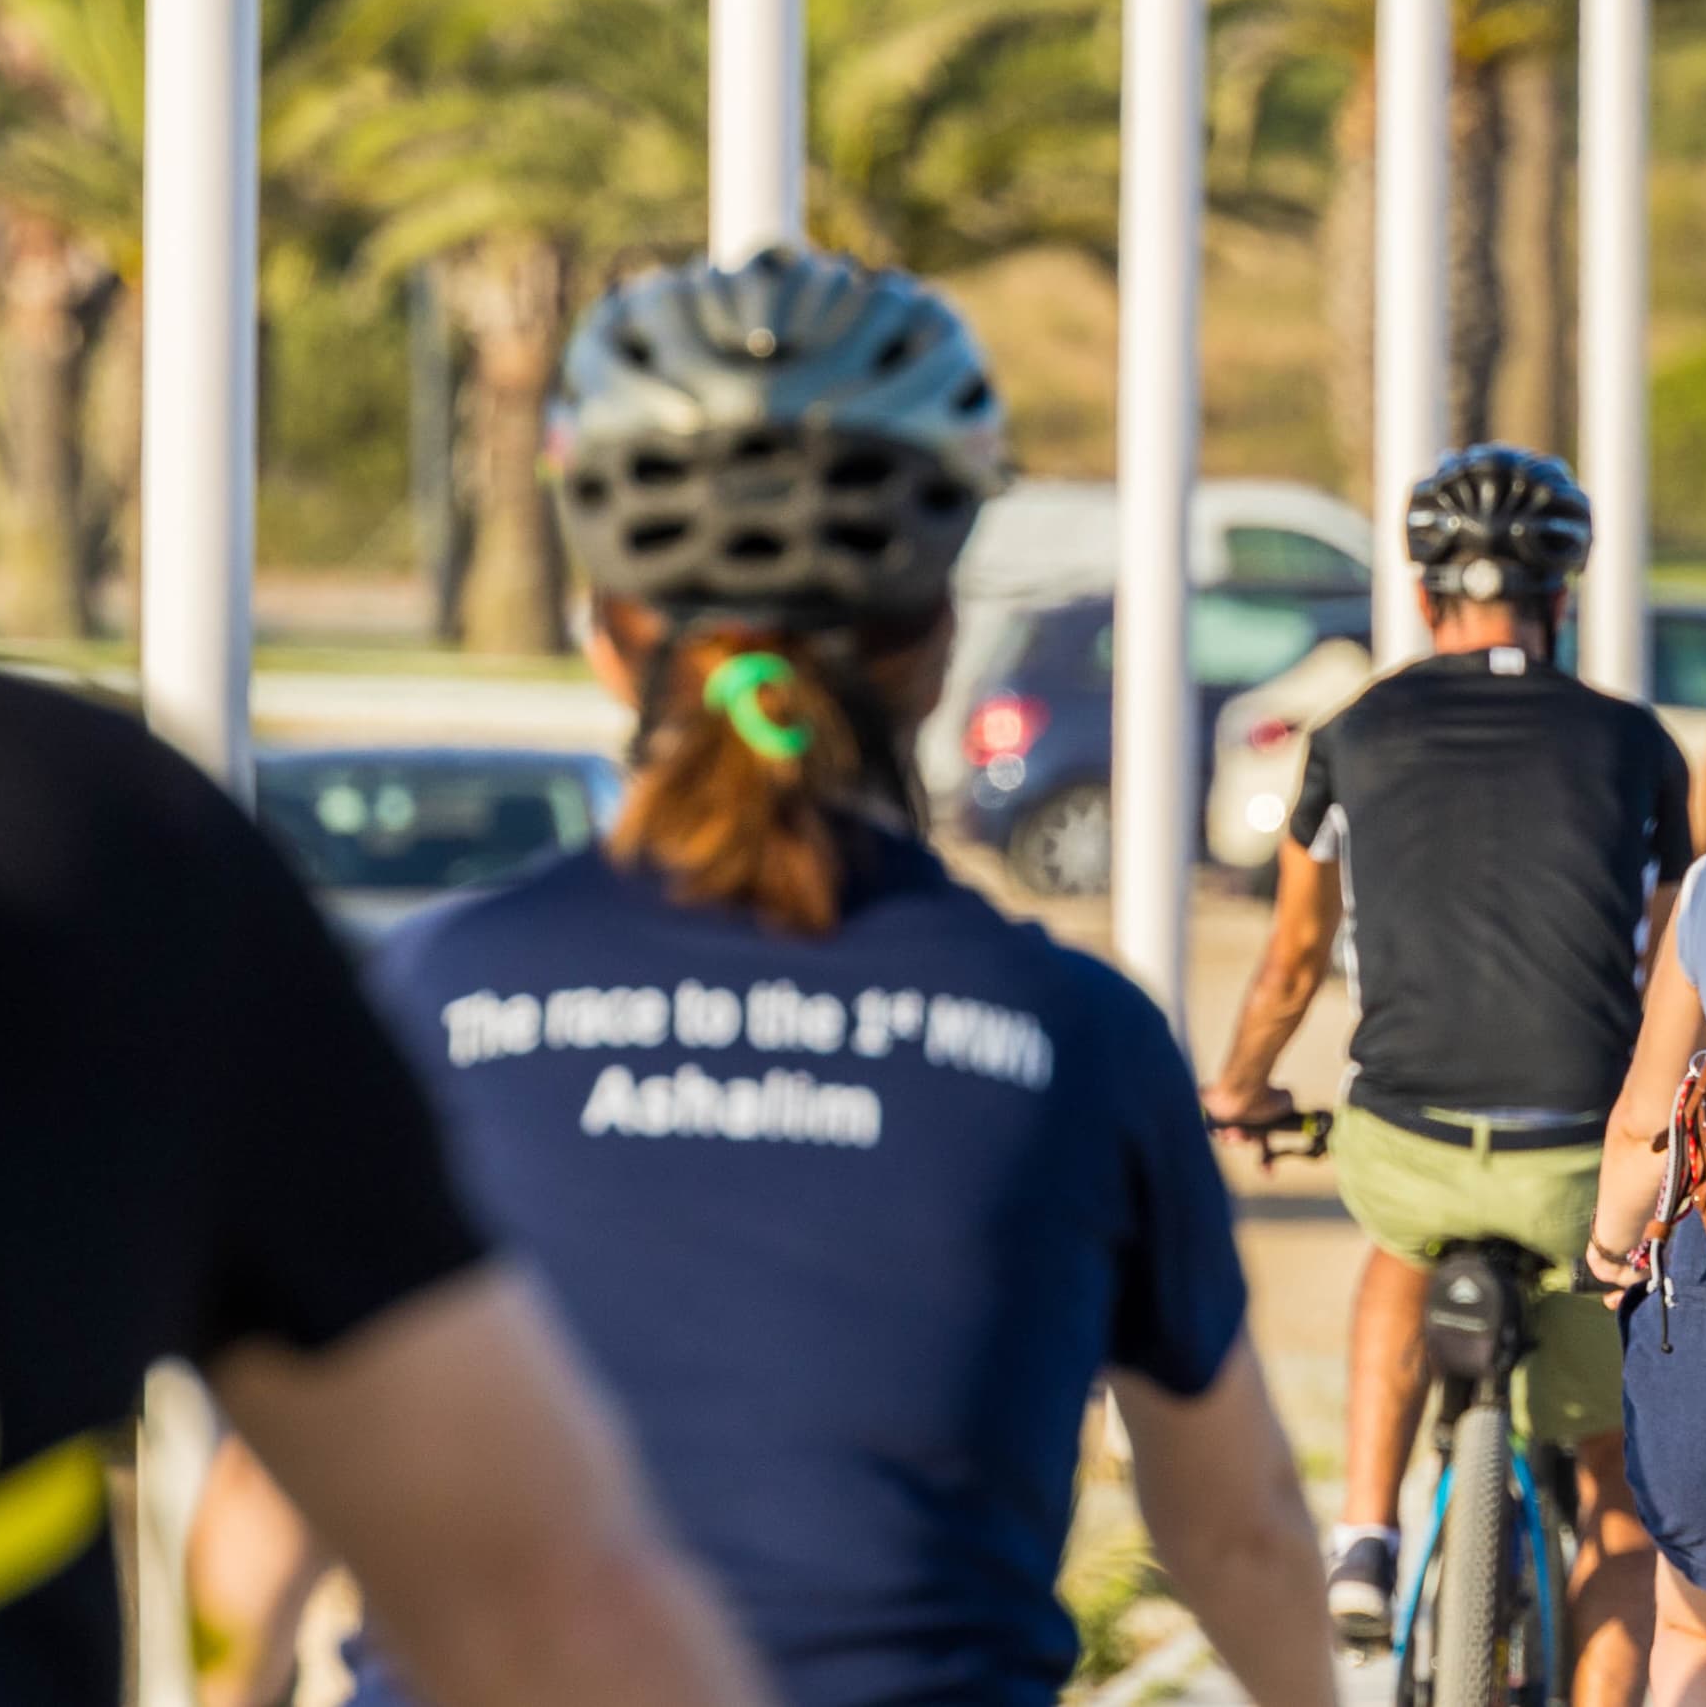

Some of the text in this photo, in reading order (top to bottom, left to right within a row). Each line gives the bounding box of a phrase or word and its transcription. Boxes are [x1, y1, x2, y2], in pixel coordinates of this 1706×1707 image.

[443, 991, 540, 1066] The
[675, 978, 740, 1048] to
[747, 978, 846, 1053] the
